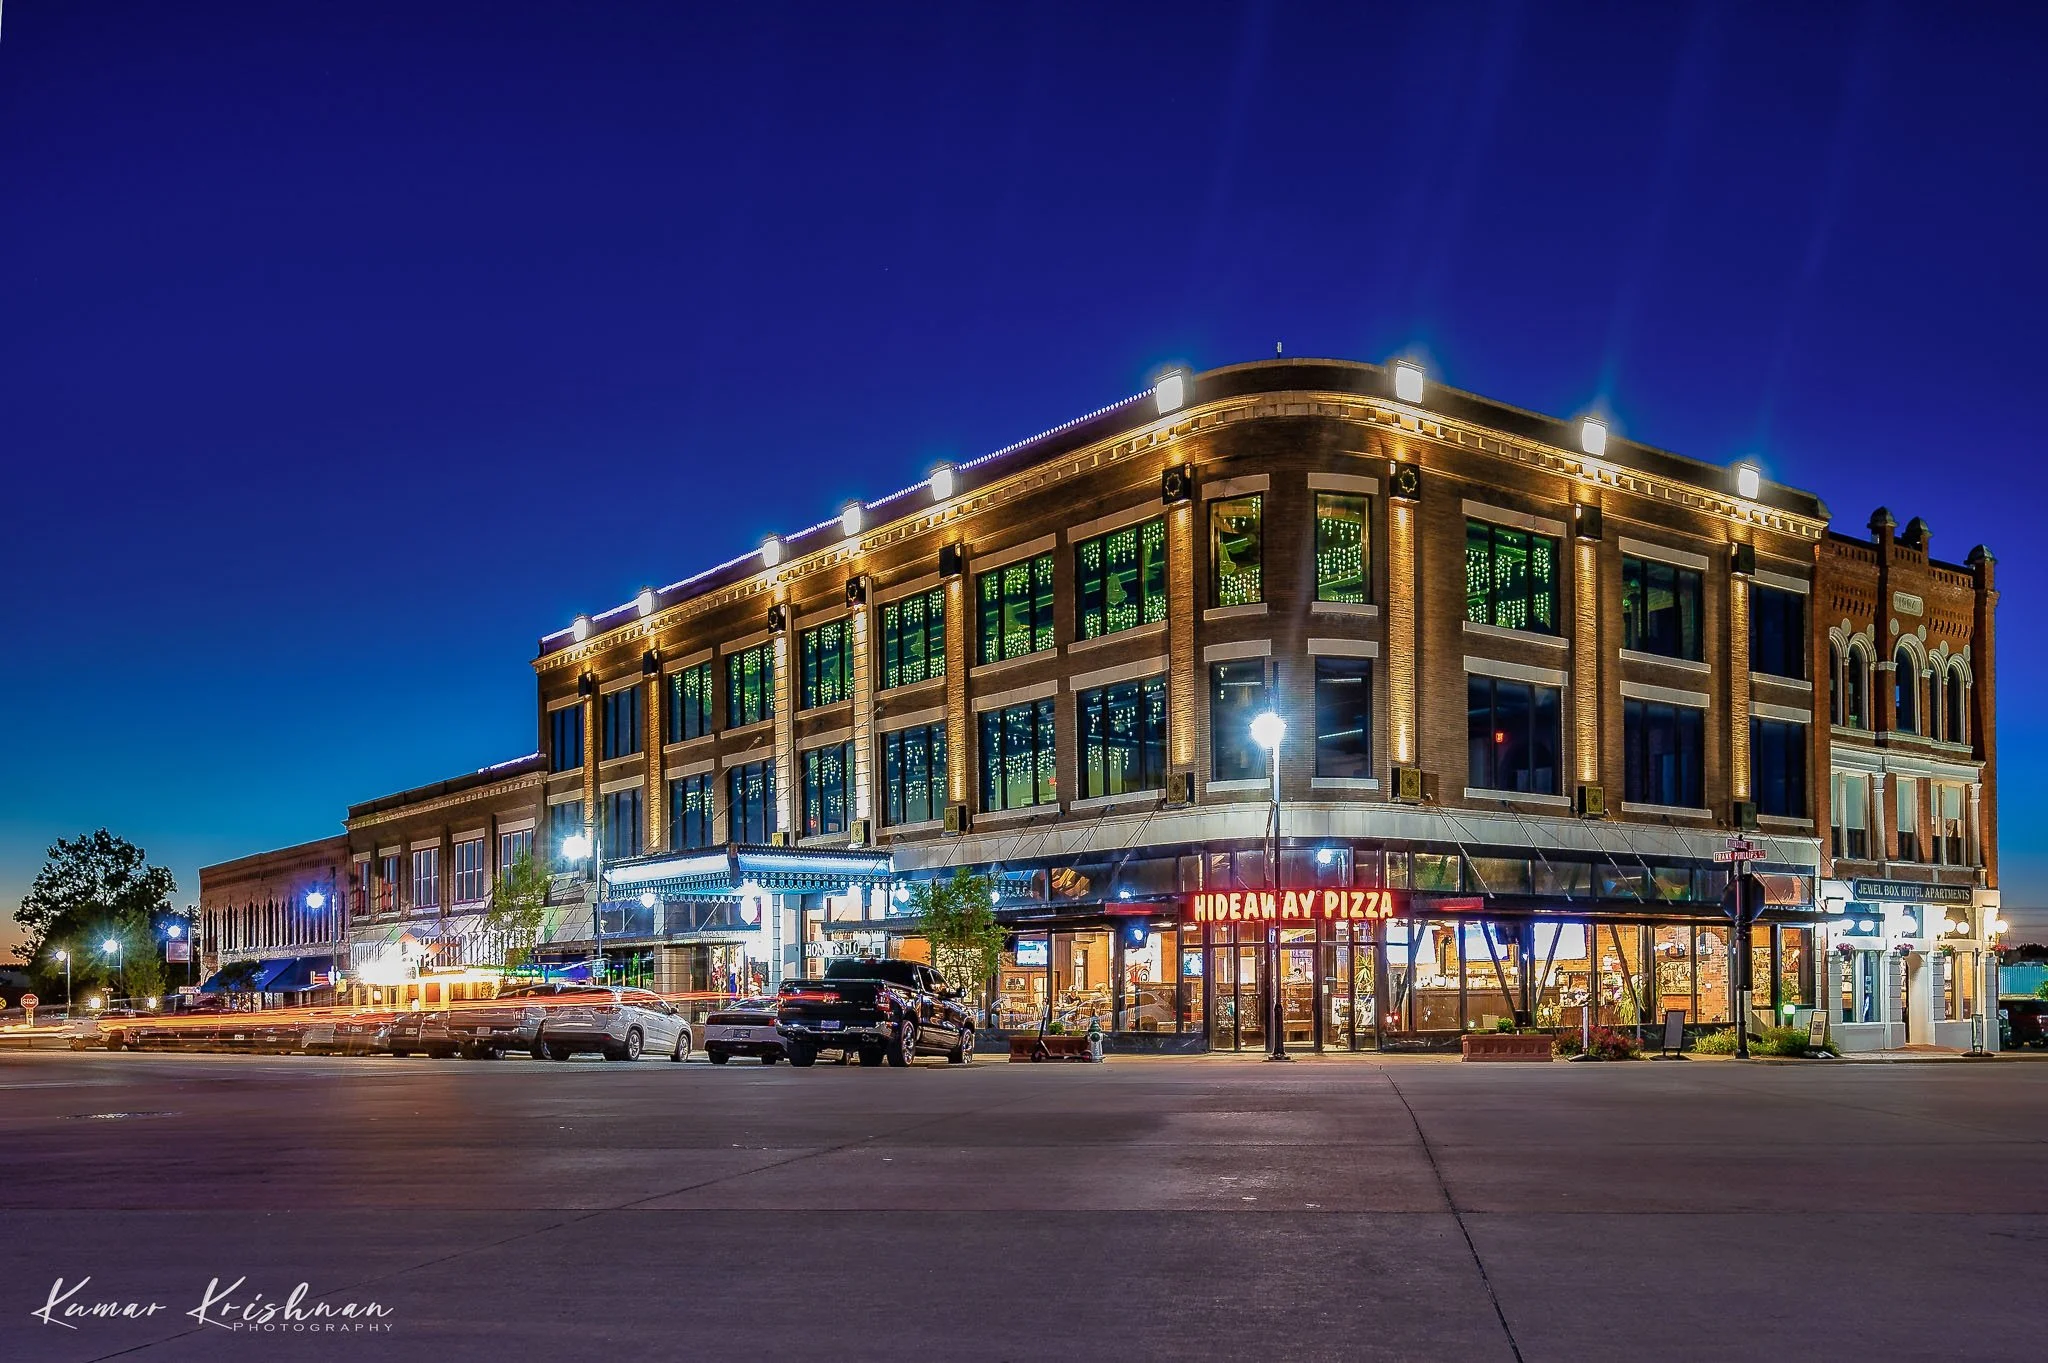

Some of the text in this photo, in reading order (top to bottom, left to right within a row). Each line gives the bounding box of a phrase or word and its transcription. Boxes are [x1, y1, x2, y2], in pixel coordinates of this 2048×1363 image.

[1715, 852, 1732, 861] FRANK
[1734, 850, 1758, 860] PHILLIPS
[1859, 883, 1970, 900] JEWEL BOX HOTEL APARTMENTS
[1193, 890, 1394, 922] HIDEAWAY PIZZA
